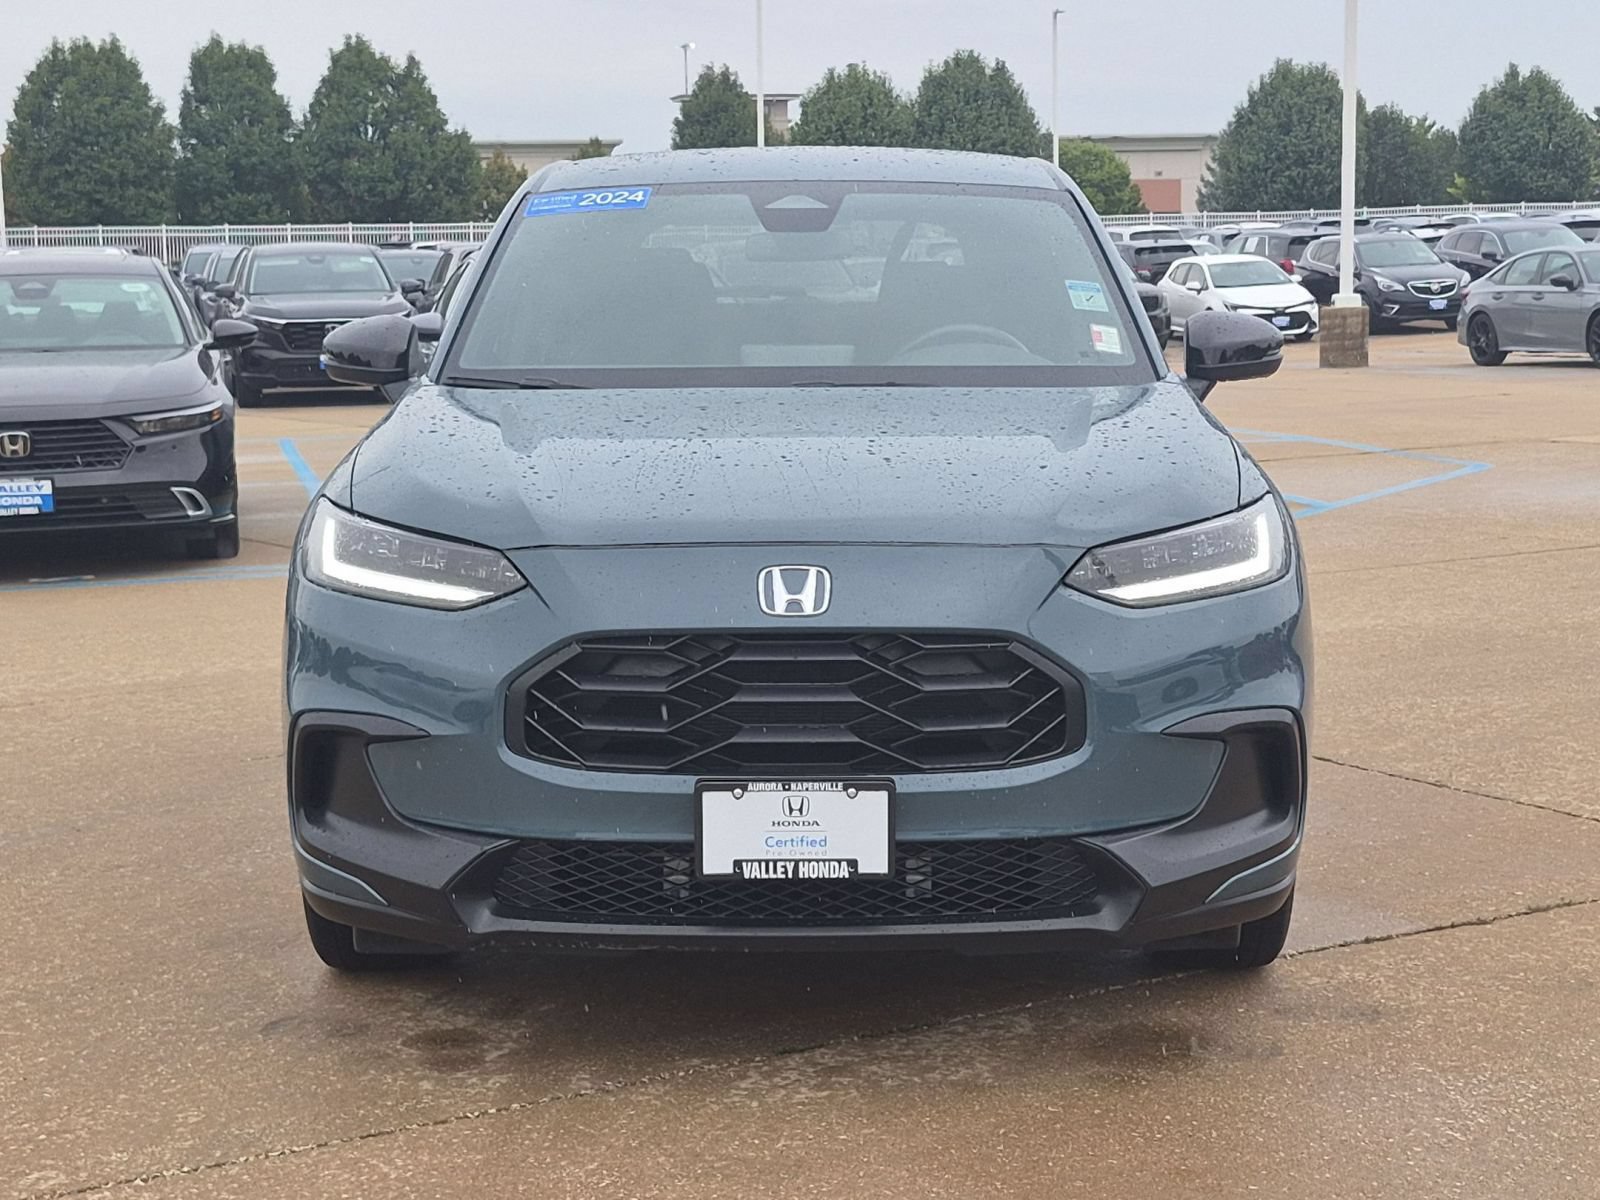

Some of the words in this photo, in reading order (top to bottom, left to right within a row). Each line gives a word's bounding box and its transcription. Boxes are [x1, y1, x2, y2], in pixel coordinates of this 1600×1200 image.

[579, 190, 645, 207] 2024
[747, 782, 784, 792] AURORA
[790, 782, 844, 792] NAPERVILLE
[771, 820, 821, 828] HONDA
[764, 835, 828, 848] Certified
[742, 861, 796, 880] VALLEY
[798, 861, 850, 879] HONDA
